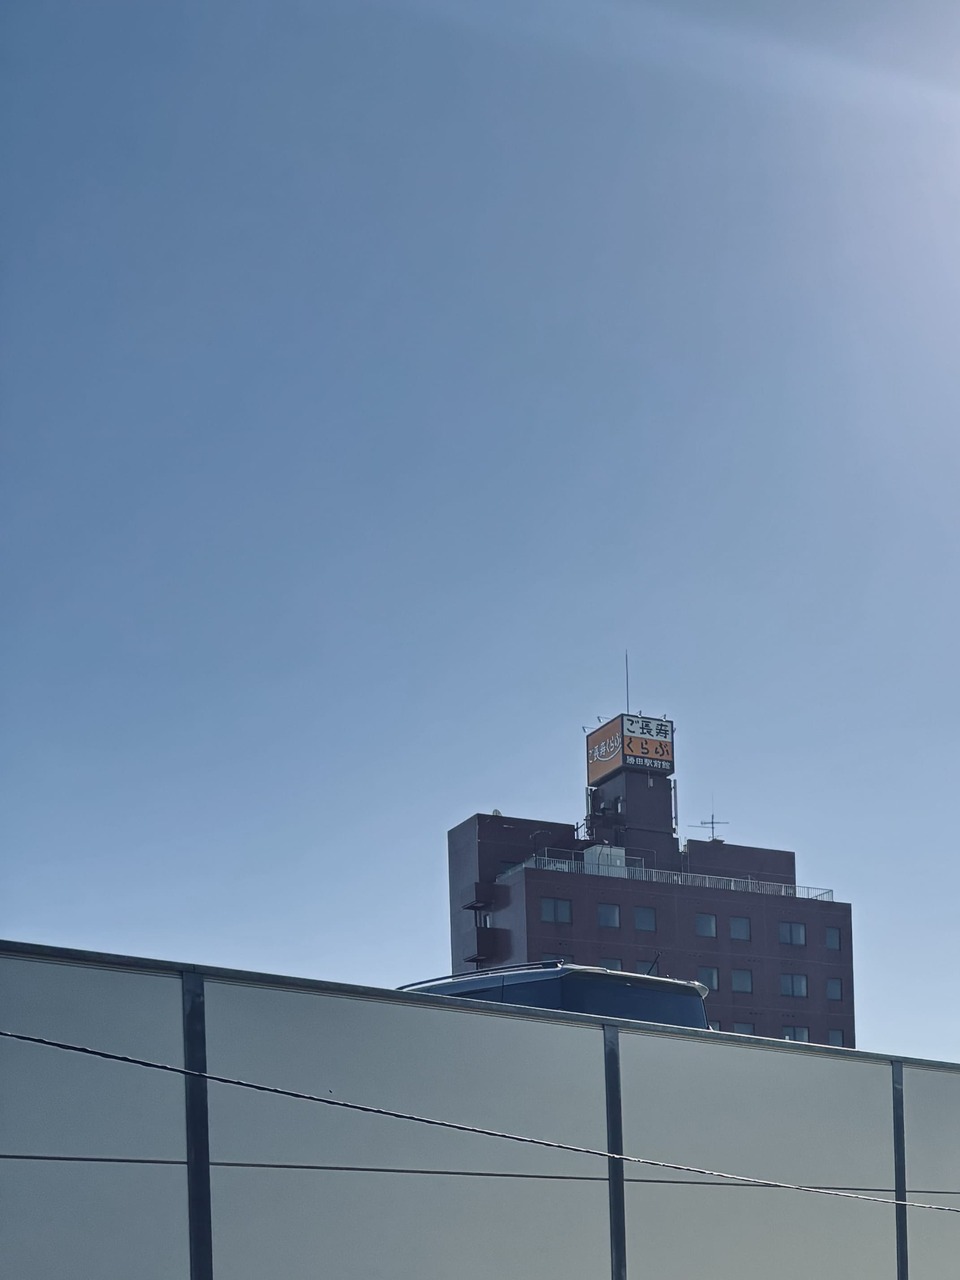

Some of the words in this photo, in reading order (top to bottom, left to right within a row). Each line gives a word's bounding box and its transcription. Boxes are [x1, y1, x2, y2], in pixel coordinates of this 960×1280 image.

[627, 718, 669, 739] ご長寿
[626, 737, 669, 757] くらぶ
